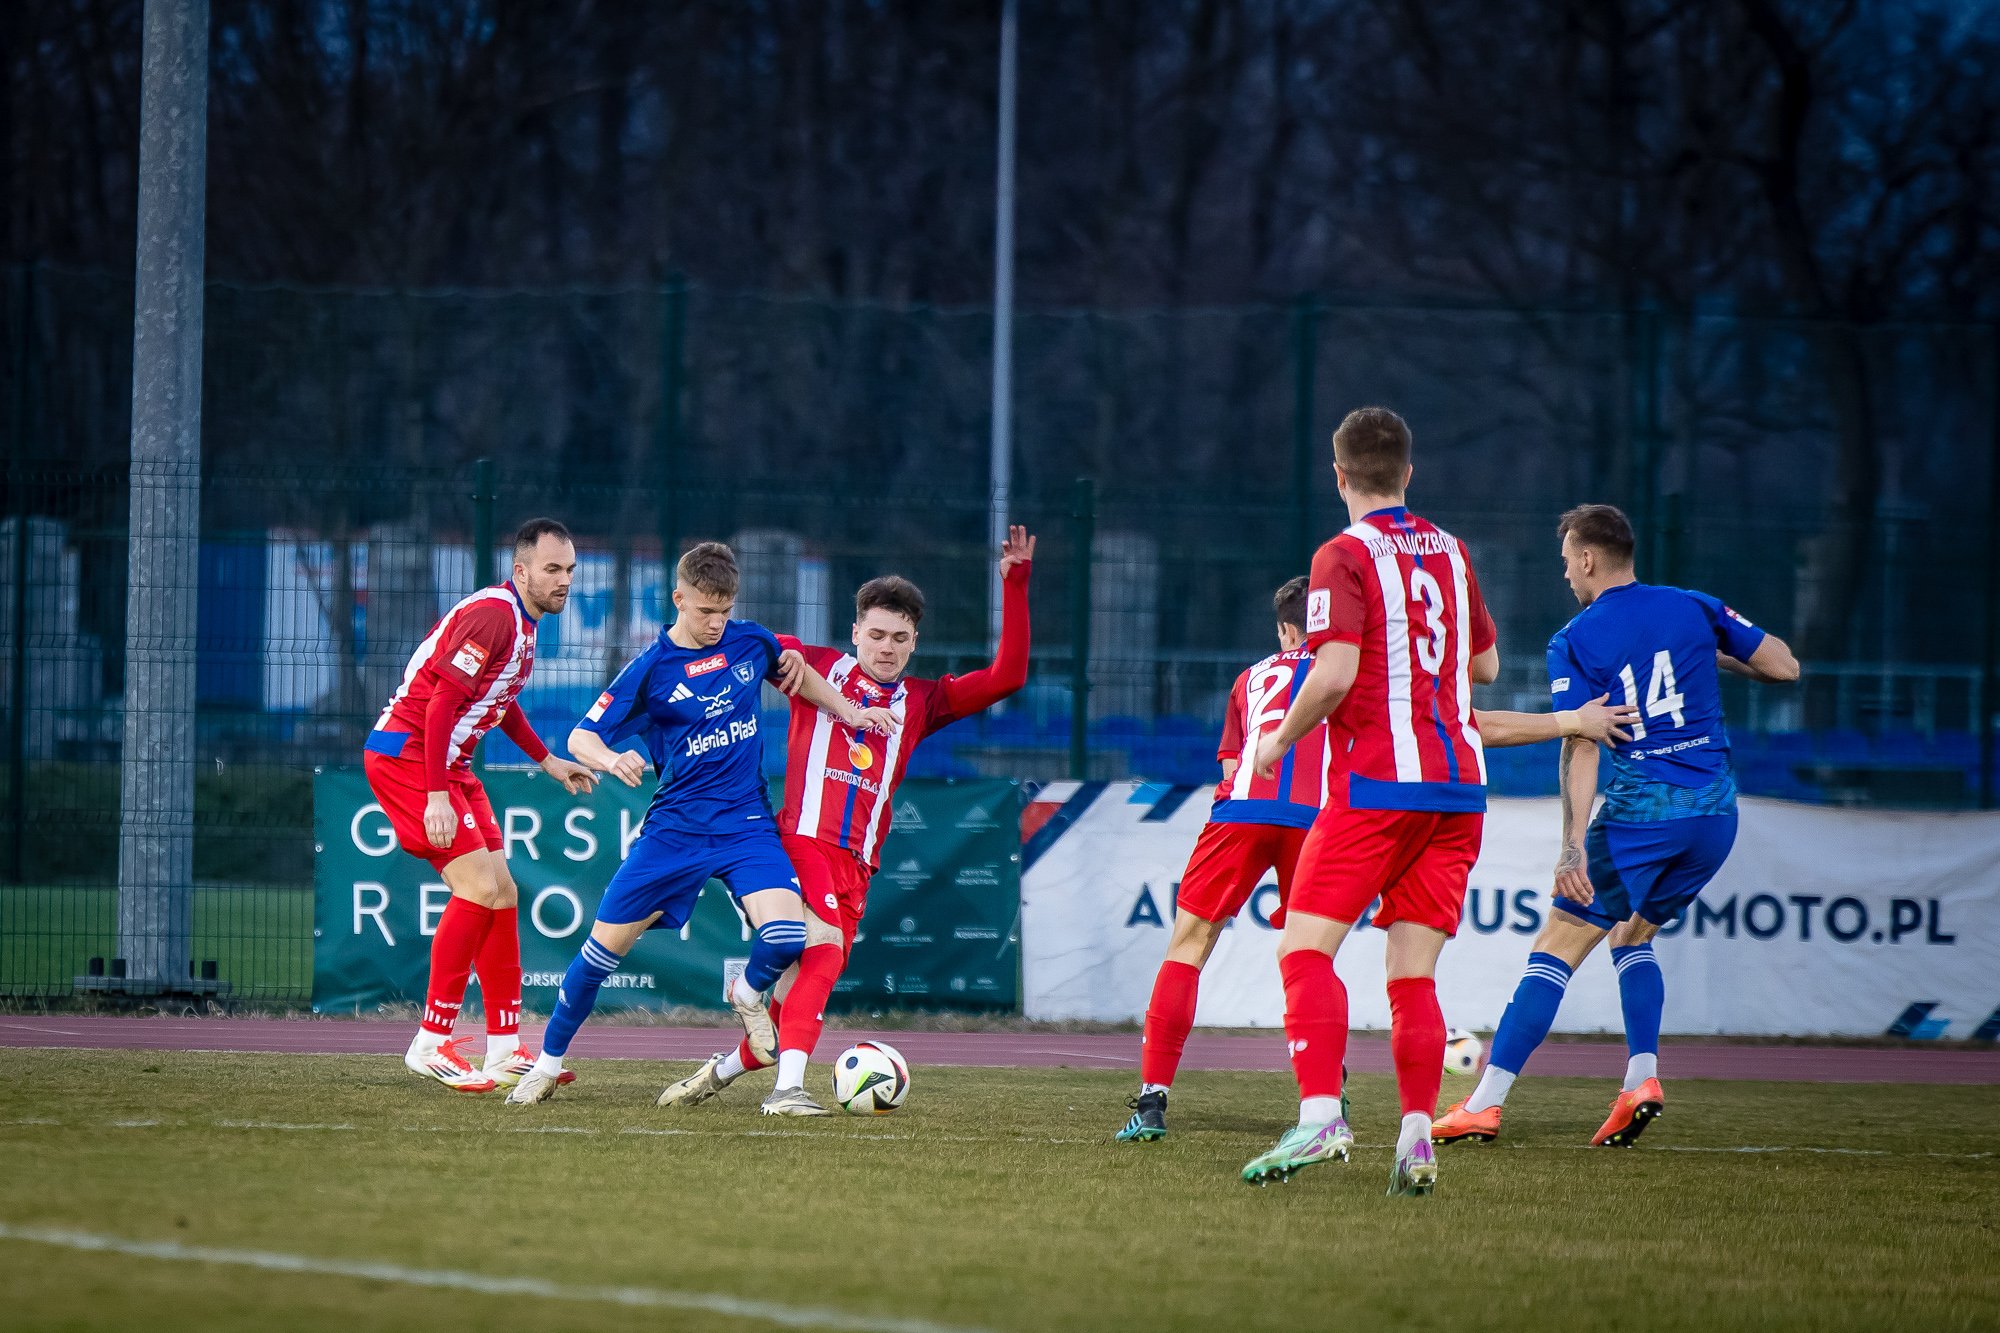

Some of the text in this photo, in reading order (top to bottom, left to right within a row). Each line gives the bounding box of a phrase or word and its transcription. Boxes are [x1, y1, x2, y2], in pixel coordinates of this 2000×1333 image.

[1411, 567, 1447, 676] 3
[688, 658, 724, 675] Betclic
[1619, 650, 1685, 741] 14
[685, 714, 758, 757] Jelenia Plast
